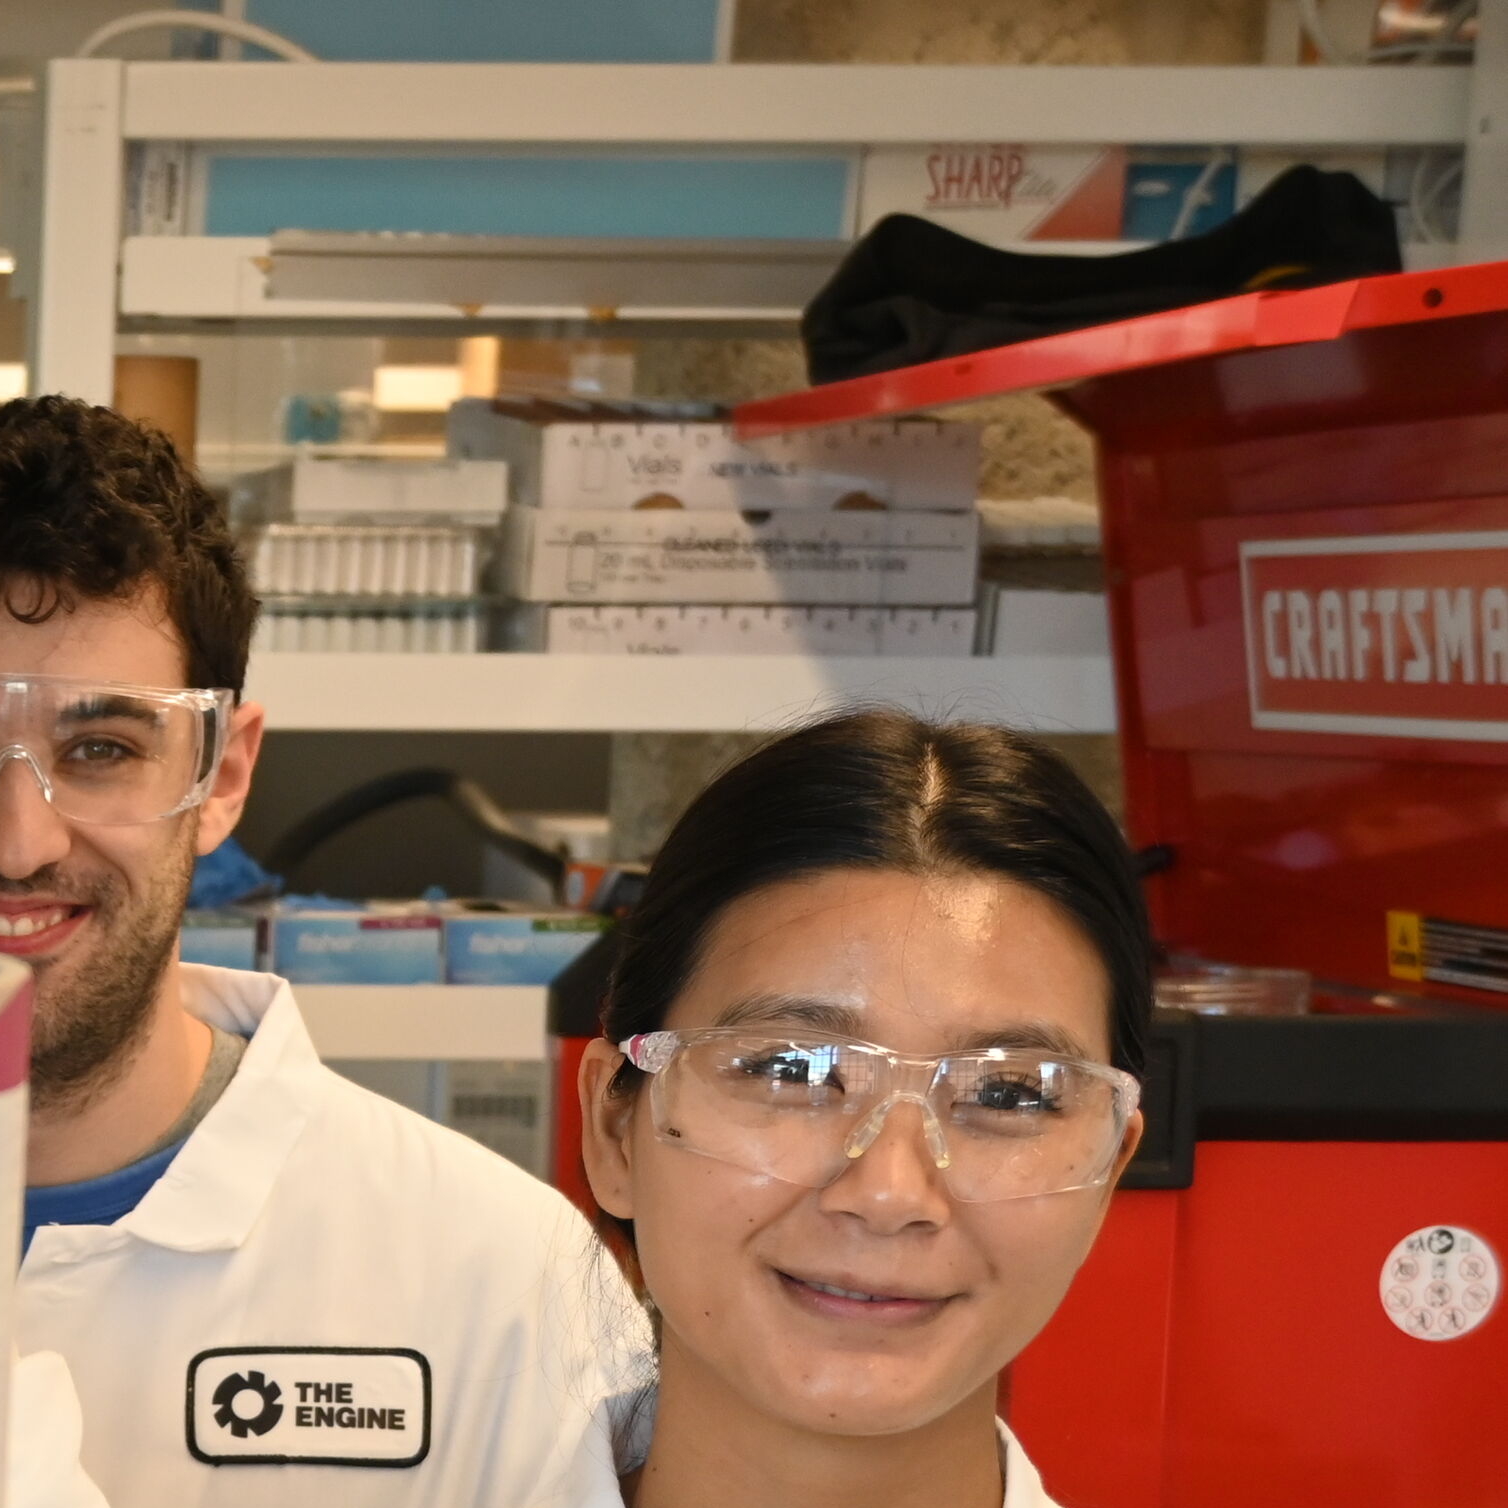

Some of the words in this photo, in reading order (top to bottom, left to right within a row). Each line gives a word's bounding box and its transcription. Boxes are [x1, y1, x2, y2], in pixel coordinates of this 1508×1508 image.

[926, 154, 1023, 209] SHARP
[295, 1382, 353, 1404] THE
[295, 1406, 406, 1430] ENGINE
